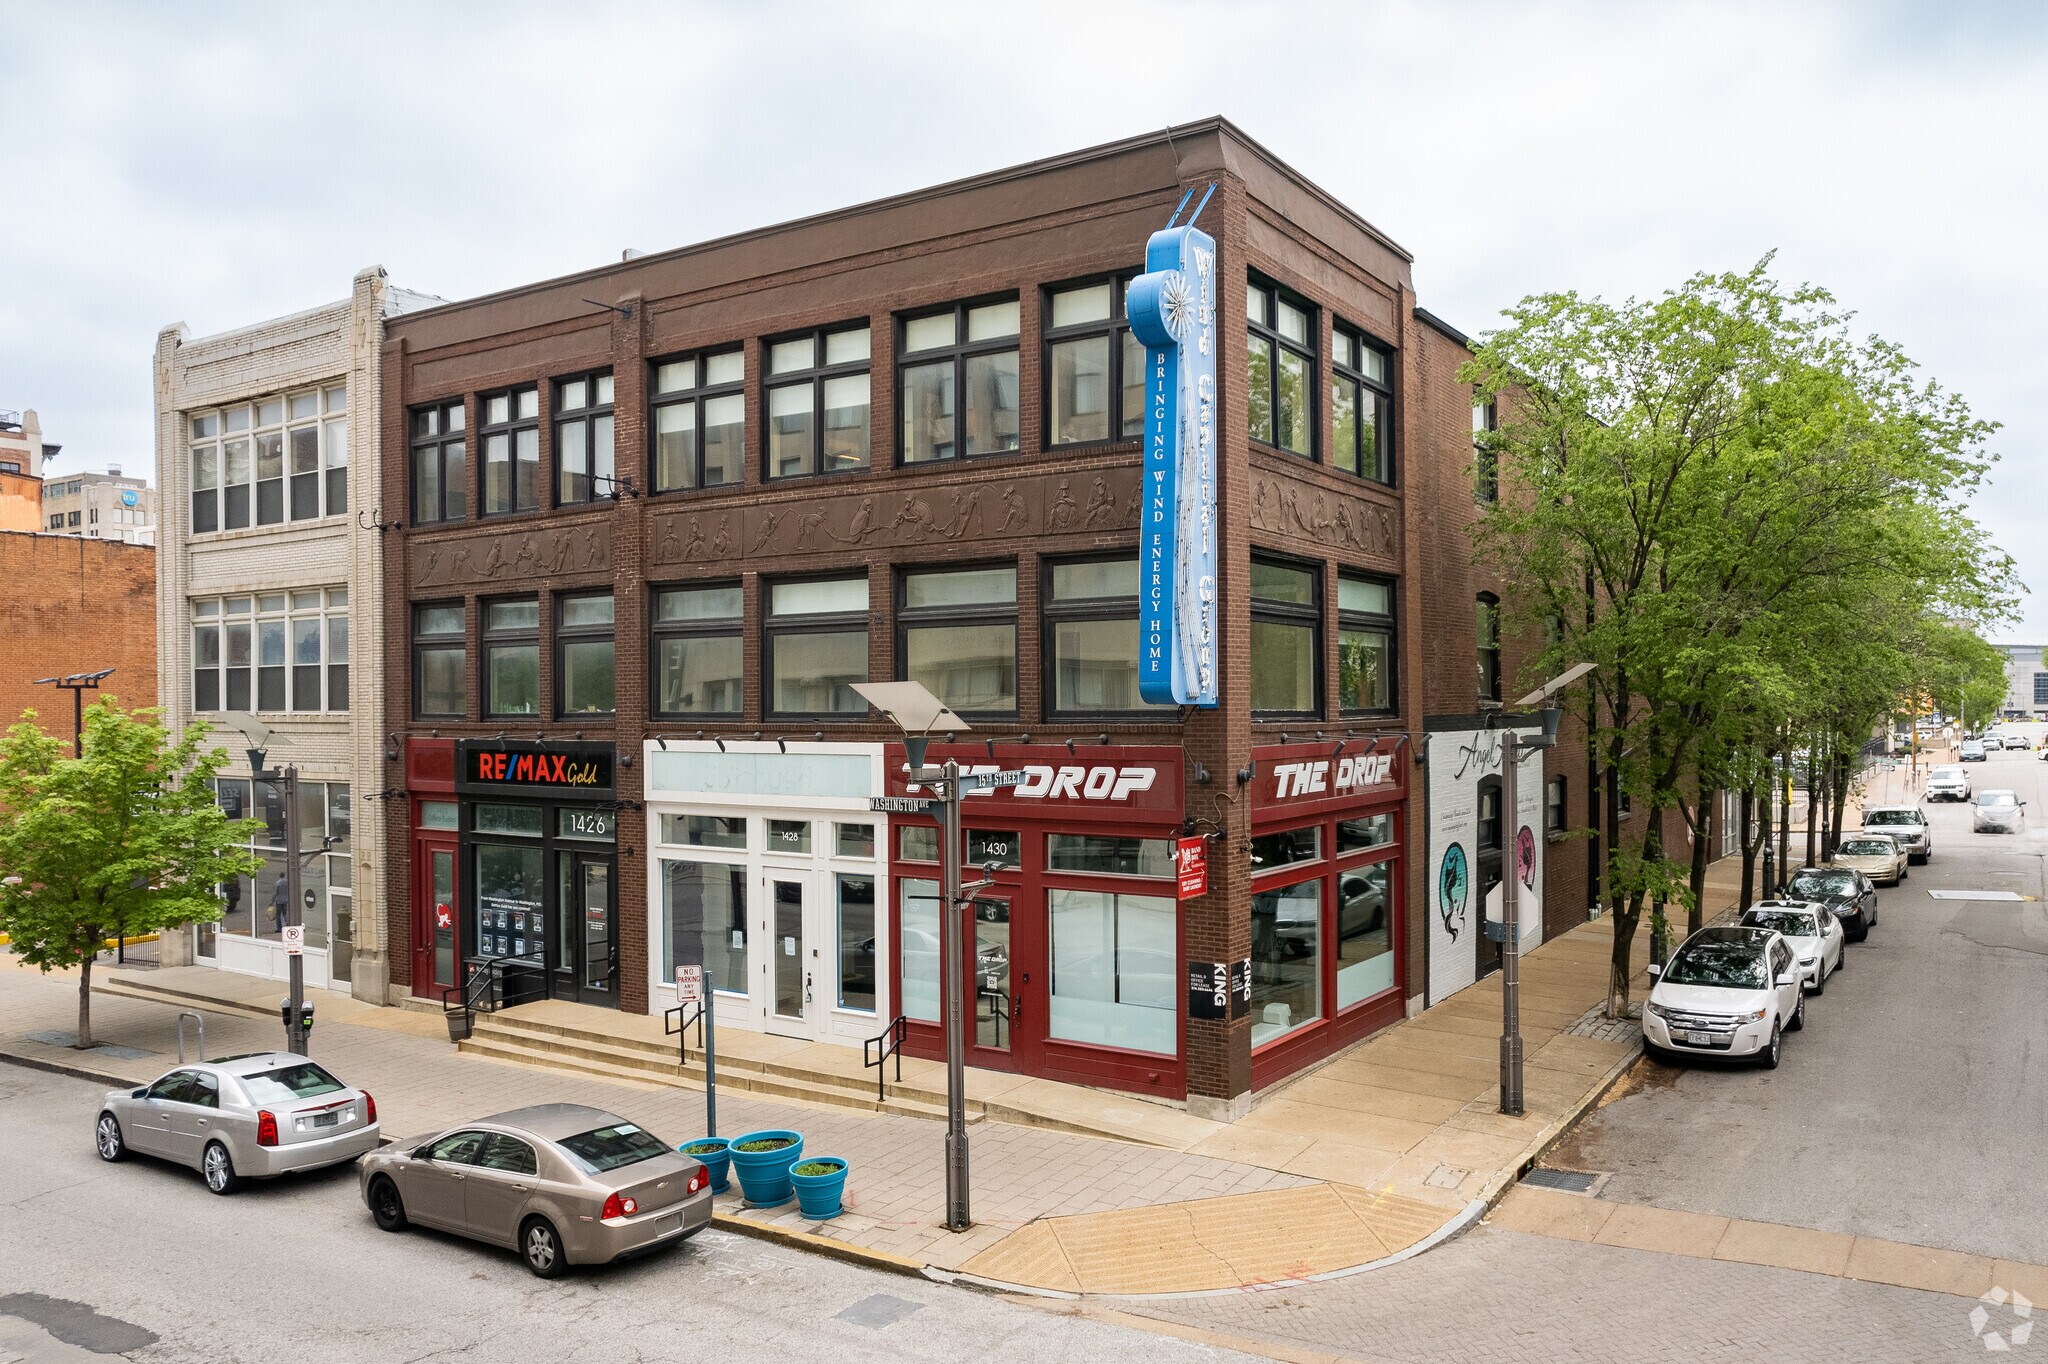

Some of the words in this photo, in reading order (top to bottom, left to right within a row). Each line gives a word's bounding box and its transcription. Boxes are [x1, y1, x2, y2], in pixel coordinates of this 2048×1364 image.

[1154, 353, 1166, 461] BRINGING
[123, 494, 135, 502] tru
[1153, 471, 1166, 523] WIND
[1151, 534, 1163, 613] ENERGY
[1150, 620, 1161, 672] HOME
[479, 752, 567, 783] RE/MAX
[567, 762, 598, 787] Gold
[994, 771, 1021, 786] STREET
[1013, 765, 1157, 800] DROP
[1273, 761, 1330, 799] THE
[1335, 754, 1392, 789] DROP
[868, 798, 919, 812] WASHINGTON
[918, 800, 930, 809] AVE
[571, 815, 606, 834] 1426
[781, 831, 799, 842] 1428
[981, 841, 1007, 856] 1430
[683, 968, 694, 976] NO
[1214, 963, 1227, 1007] KING
[1243, 957, 1251, 1001] KING
